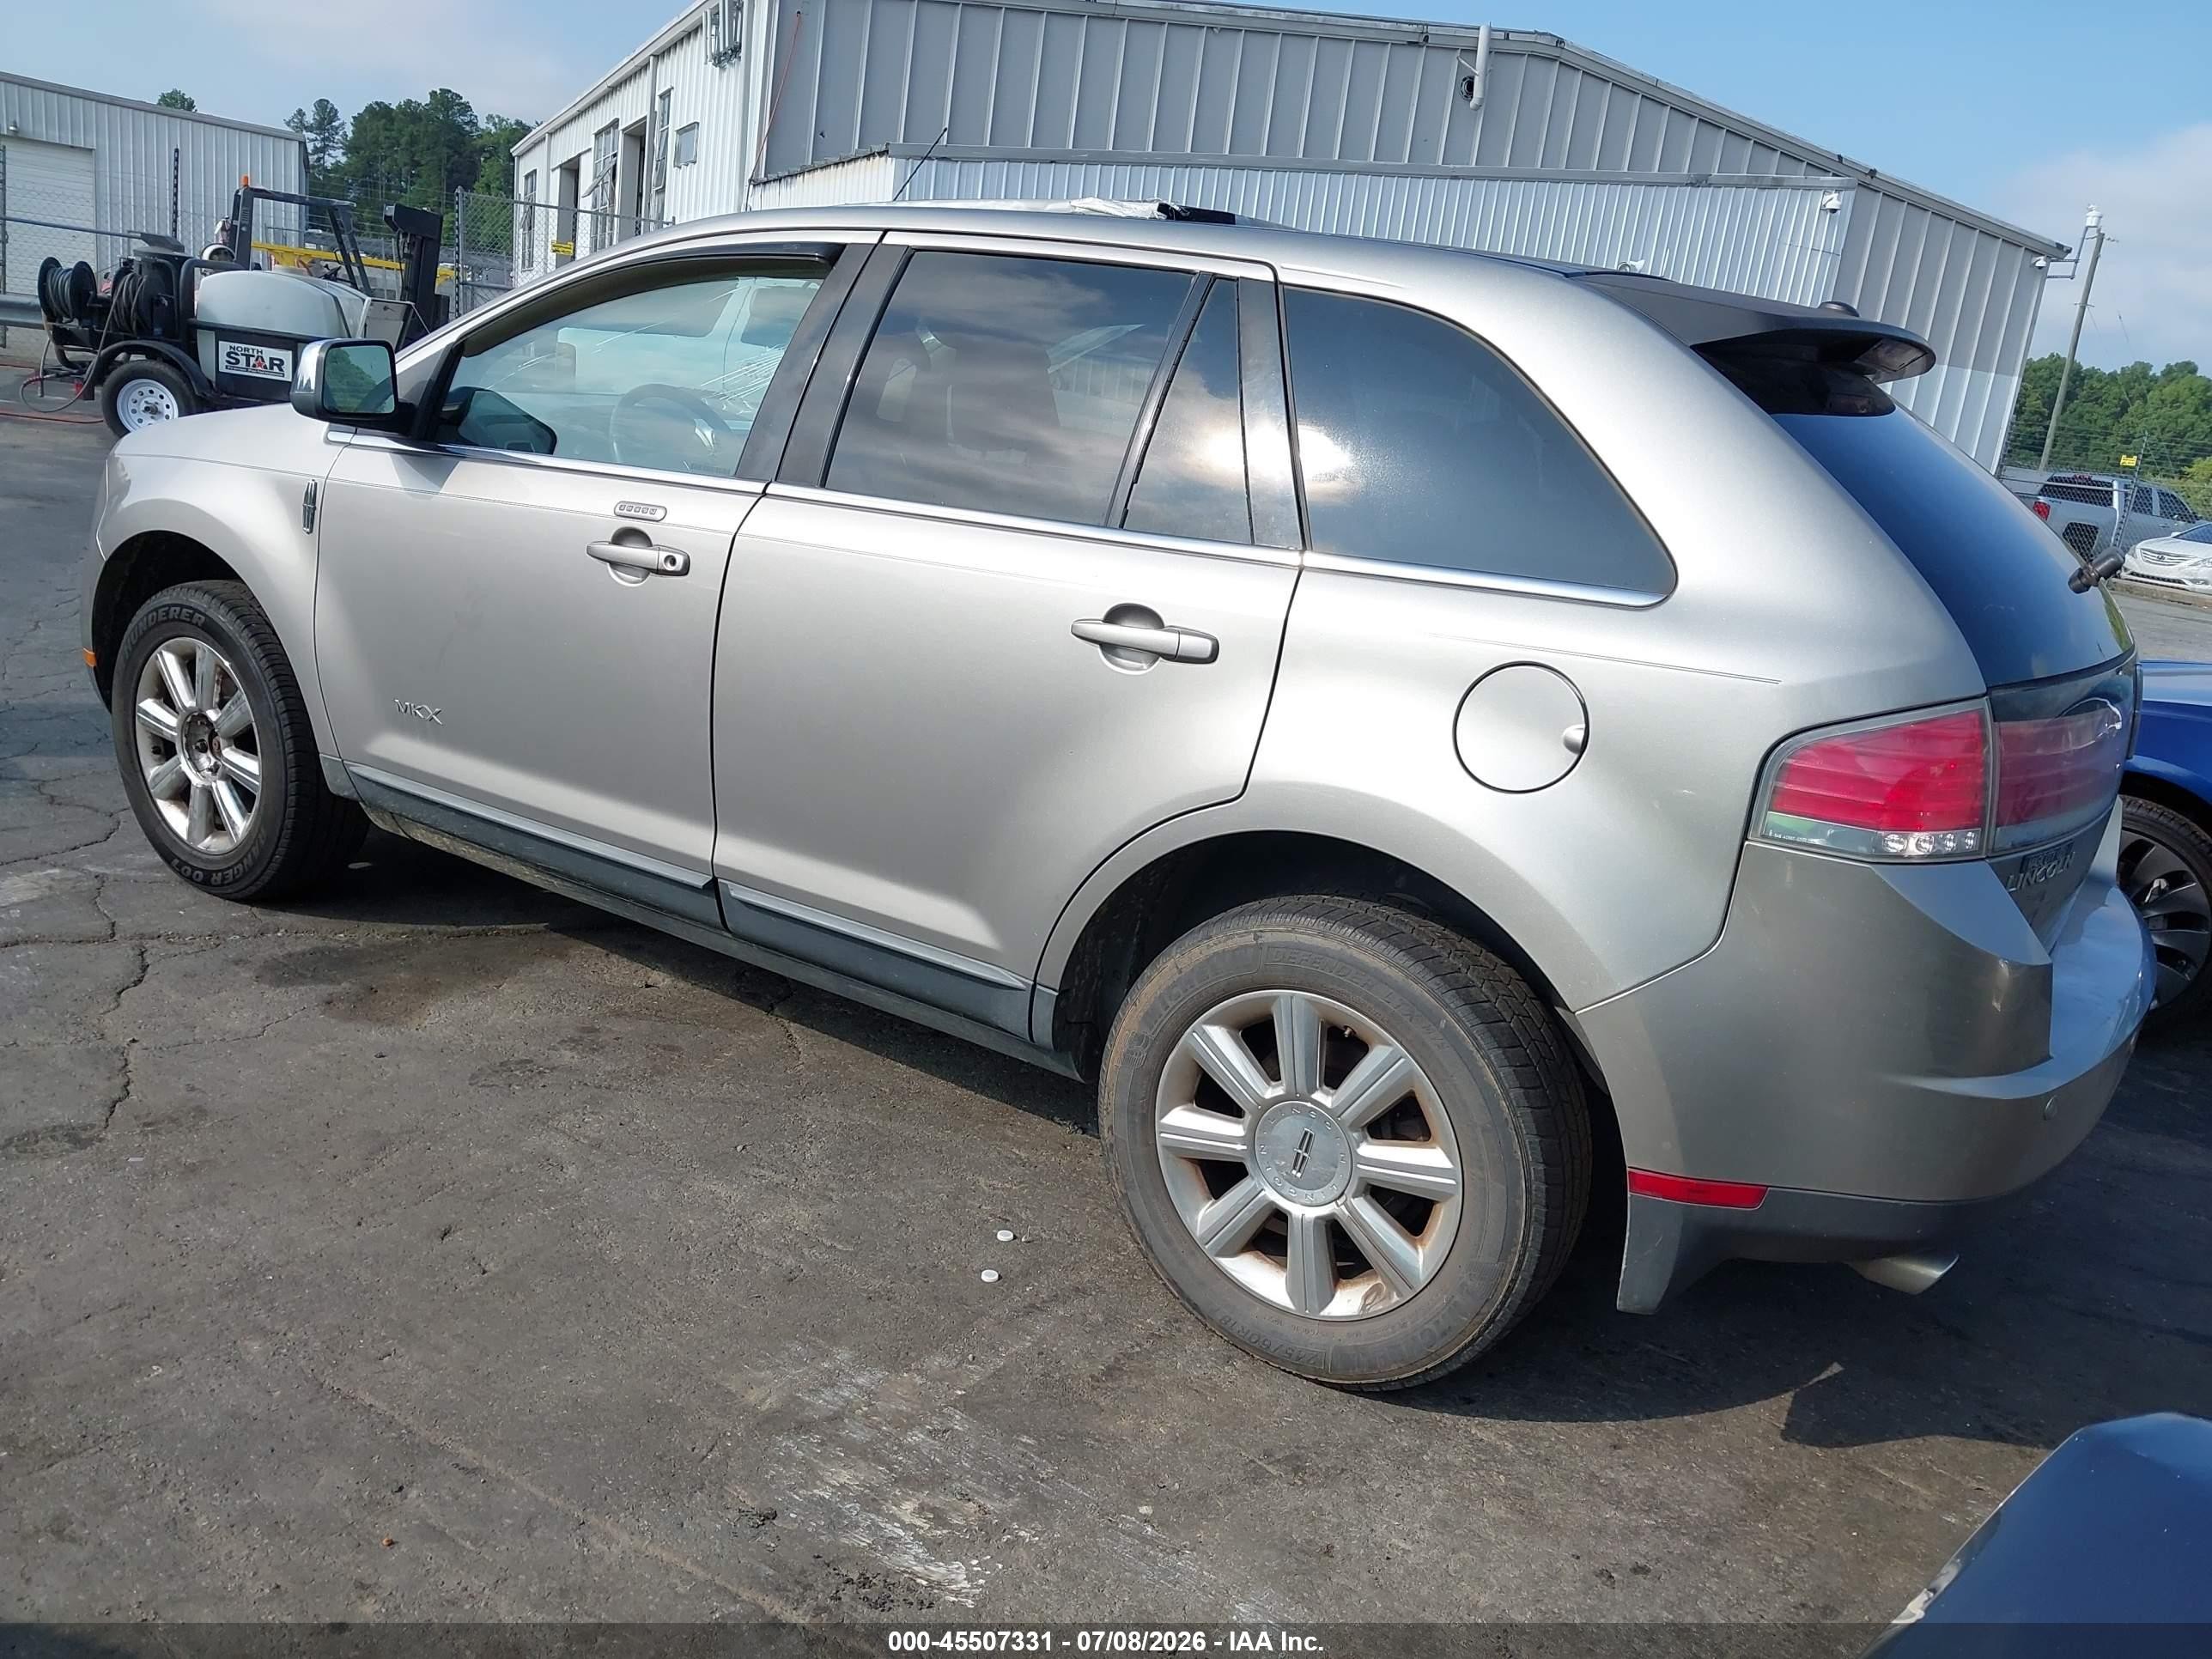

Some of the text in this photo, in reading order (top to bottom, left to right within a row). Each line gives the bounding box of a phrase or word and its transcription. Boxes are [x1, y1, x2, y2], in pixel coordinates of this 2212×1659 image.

[225, 350, 285, 372] STAR
[228, 345, 263, 356] NORTH
[394, 699, 443, 725] MKX
[2006, 851, 2075, 892] LINCOLN
